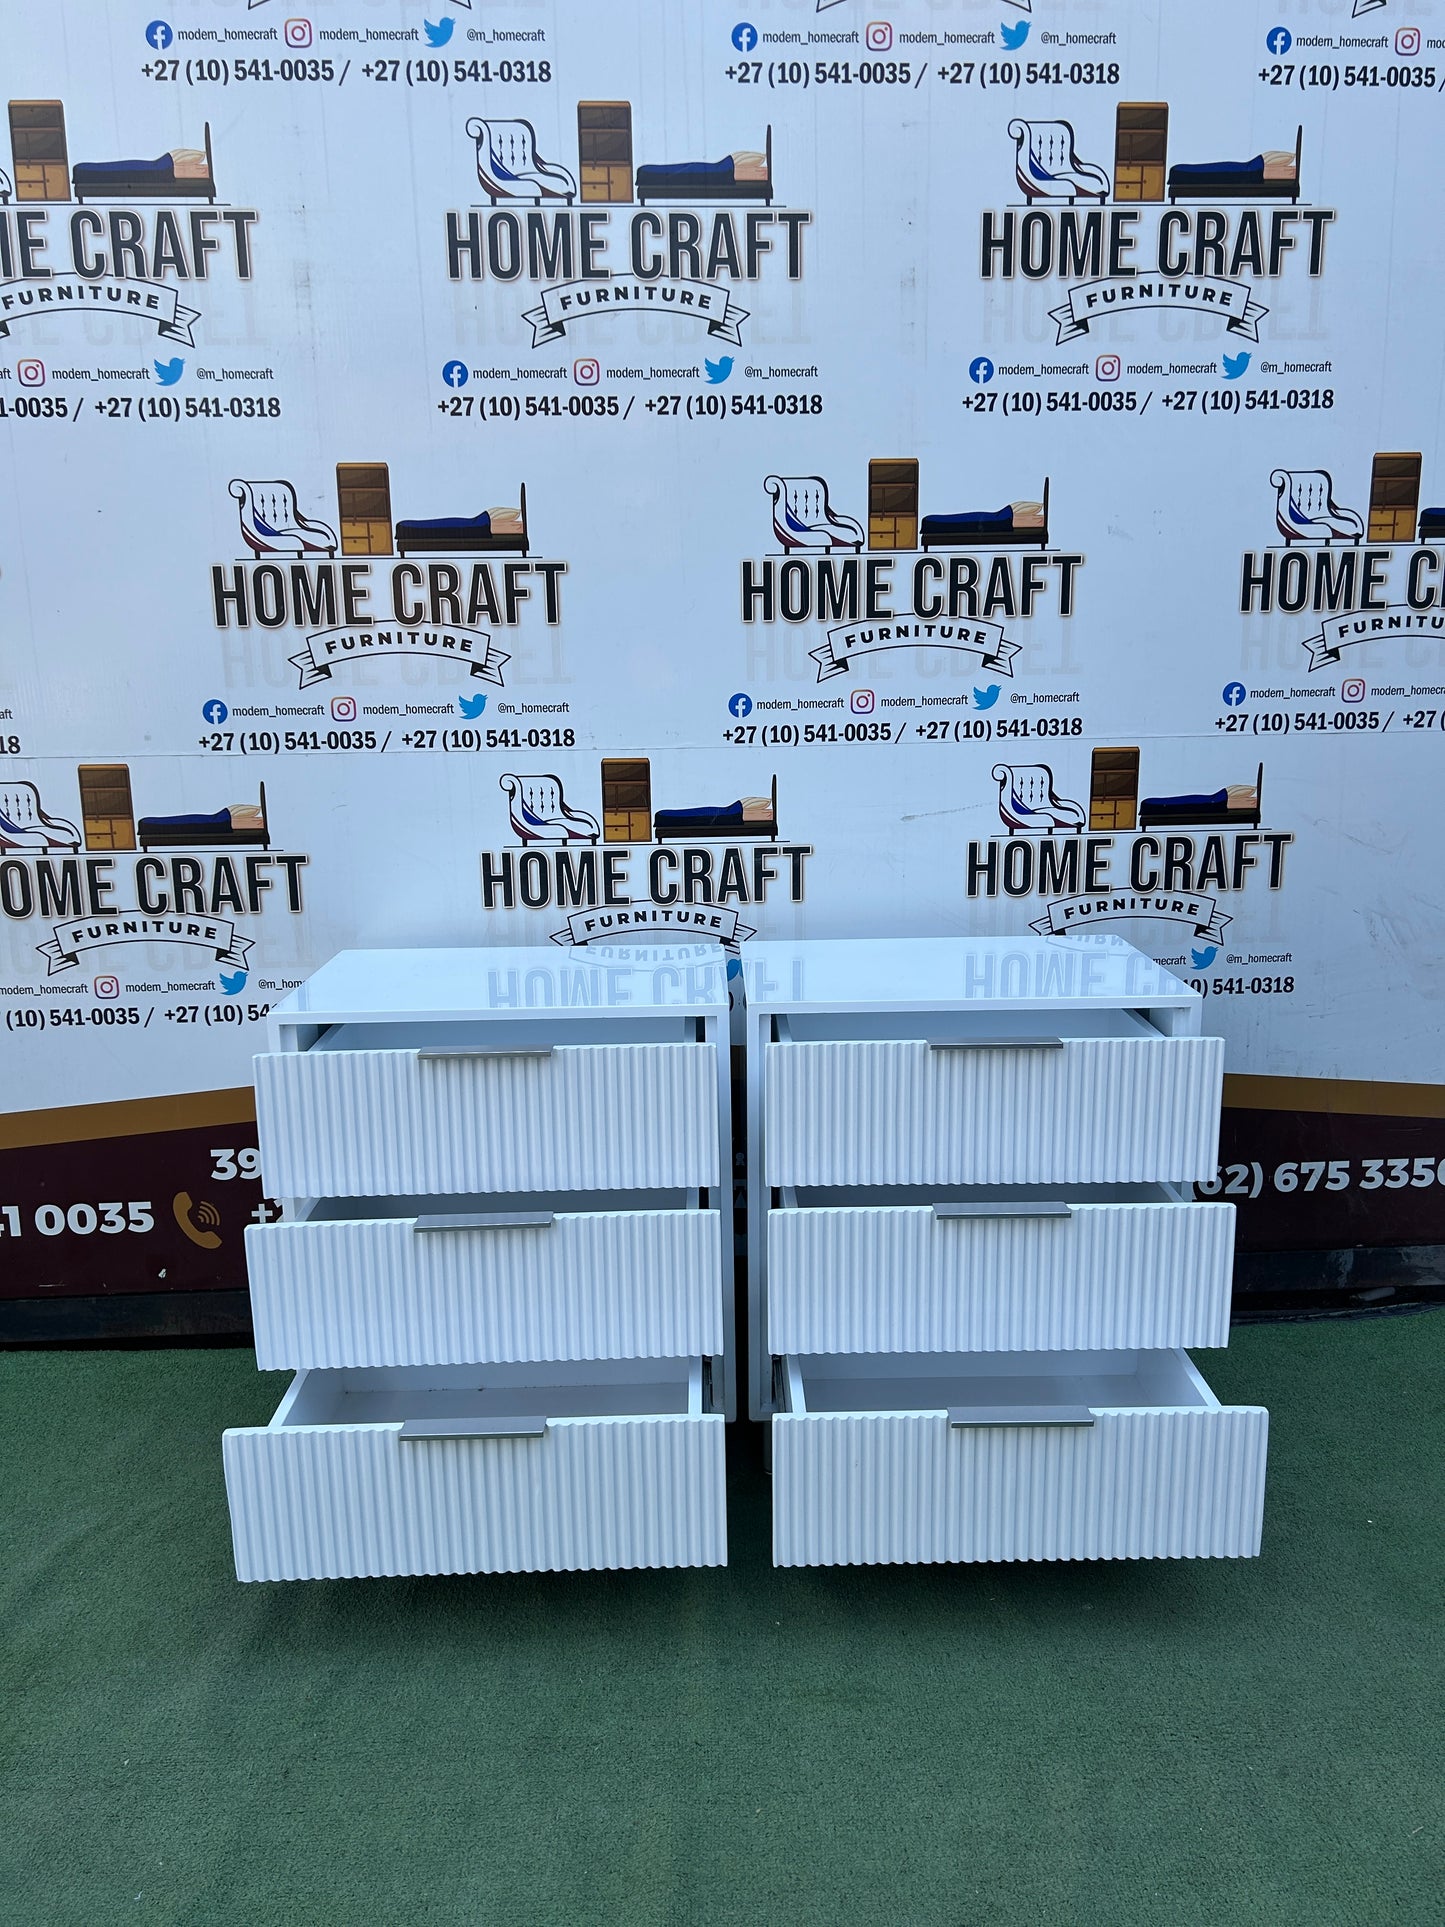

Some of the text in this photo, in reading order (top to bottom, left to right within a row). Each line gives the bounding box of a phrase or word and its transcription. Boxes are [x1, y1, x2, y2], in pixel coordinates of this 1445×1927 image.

[467, 29, 545, 43] @m_homecraft
[1041, 32, 1116, 46] @m_homecraft
[142, 60, 179, 80] +27
[186, 59, 229, 86] (10)
[235, 59, 334, 81] 541-0035
[362, 60, 400, 81] +27
[406, 60, 448, 86] (10)
[454, 60, 551, 82] 541-0318
[725, 62, 762, 83] +27
[769, 62, 809, 88] (10)
[815, 62, 910, 84] 541-0035
[938, 63, 974, 83] +27
[980, 63, 1020, 89] (10)
[1026, 63, 1119, 84] 541-0318
[1259, 65, 1295, 85] +27
[1300, 65, 1339, 90] (10)
[1344, 66, 1435, 87] 541-0035
[70, 209, 257, 280] CRAFT
[445, 210, 812, 281] HOME CRAFT
[980, 209, 1336, 278] HOME CRAFT
[2, 285, 160, 310] FURNITURE
[560, 286, 712, 310] FURNITURE
[1087, 283, 1234, 308] FURNITURE
[197, 368, 274, 381] @m_homecraft
[745, 366, 818, 379] @m_homecraft
[1261, 361, 1332, 374] @m_homecraft
[95, 398, 132, 417] +27
[139, 398, 180, 422] (10)
[186, 397, 280, 417] 541-0318
[438, 397, 474, 416] +27
[480, 397, 520, 421] (10)
[526, 396, 619, 416] 541-0035
[645, 396, 681, 415] +27
[687, 395, 726, 419] (10)
[731, 395, 822, 415] 541-0318
[963, 393, 998, 412] +27
[1003, 392, 1041, 416] (10)
[1047, 392, 1136, 411] 541-0035
[1162, 391, 1197, 410] +27
[1202, 391, 1240, 414] (10)
[1245, 389, 1333, 409] 541-0318
[741, 555, 1082, 622] HOME CRAFT
[1240, 550, 1391, 613] HOME
[210, 562, 567, 628] HOME CRAFT
[325, 632, 473, 654] FURNITURE
[845, 625, 987, 648] FURNITURE
[498, 702, 569, 715] @m_homecraft
[1011, 692, 1079, 705] @m_homecraft
[723, 726, 756, 744] +27
[762, 725, 799, 747] (10)
[804, 723, 891, 742] 541-0035
[916, 721, 949, 739] +27
[955, 720, 991, 742] (10)
[997, 718, 1082, 737] 541-0318
[1215, 714, 1249, 732] +27
[1253, 714, 1289, 735] (10)
[1294, 712, 1379, 730] 541-0035
[1403, 711, 1436, 728] +27
[199, 733, 234, 751] +27
[240, 732, 279, 755] (10)
[285, 731, 376, 750] 541-0035
[402, 730, 436, 748] +27
[443, 730, 481, 752] (10)
[486, 729, 575, 747] 541-0318
[481, 845, 812, 909] HOME CRAFT
[966, 833, 1293, 897] HOME CRAFT
[135, 855, 308, 916] CRAFT
[585, 910, 722, 932] FURNITURE
[1064, 898, 1200, 920] FURNITURE
[71, 920, 217, 943] FURNITURE
[1226, 953, 1292, 965] @m_homecraft
[1212, 977, 1294, 995] 541-0318
[7, 1010, 45, 1031] (10)
[50, 1008, 139, 1026] 541-0035
[165, 1006, 198, 1023] +27
[205, 1005, 243, 1026] (10)
[1274, 1160, 1350, 1193] 675
[34, 1201, 155, 1236] 0035
